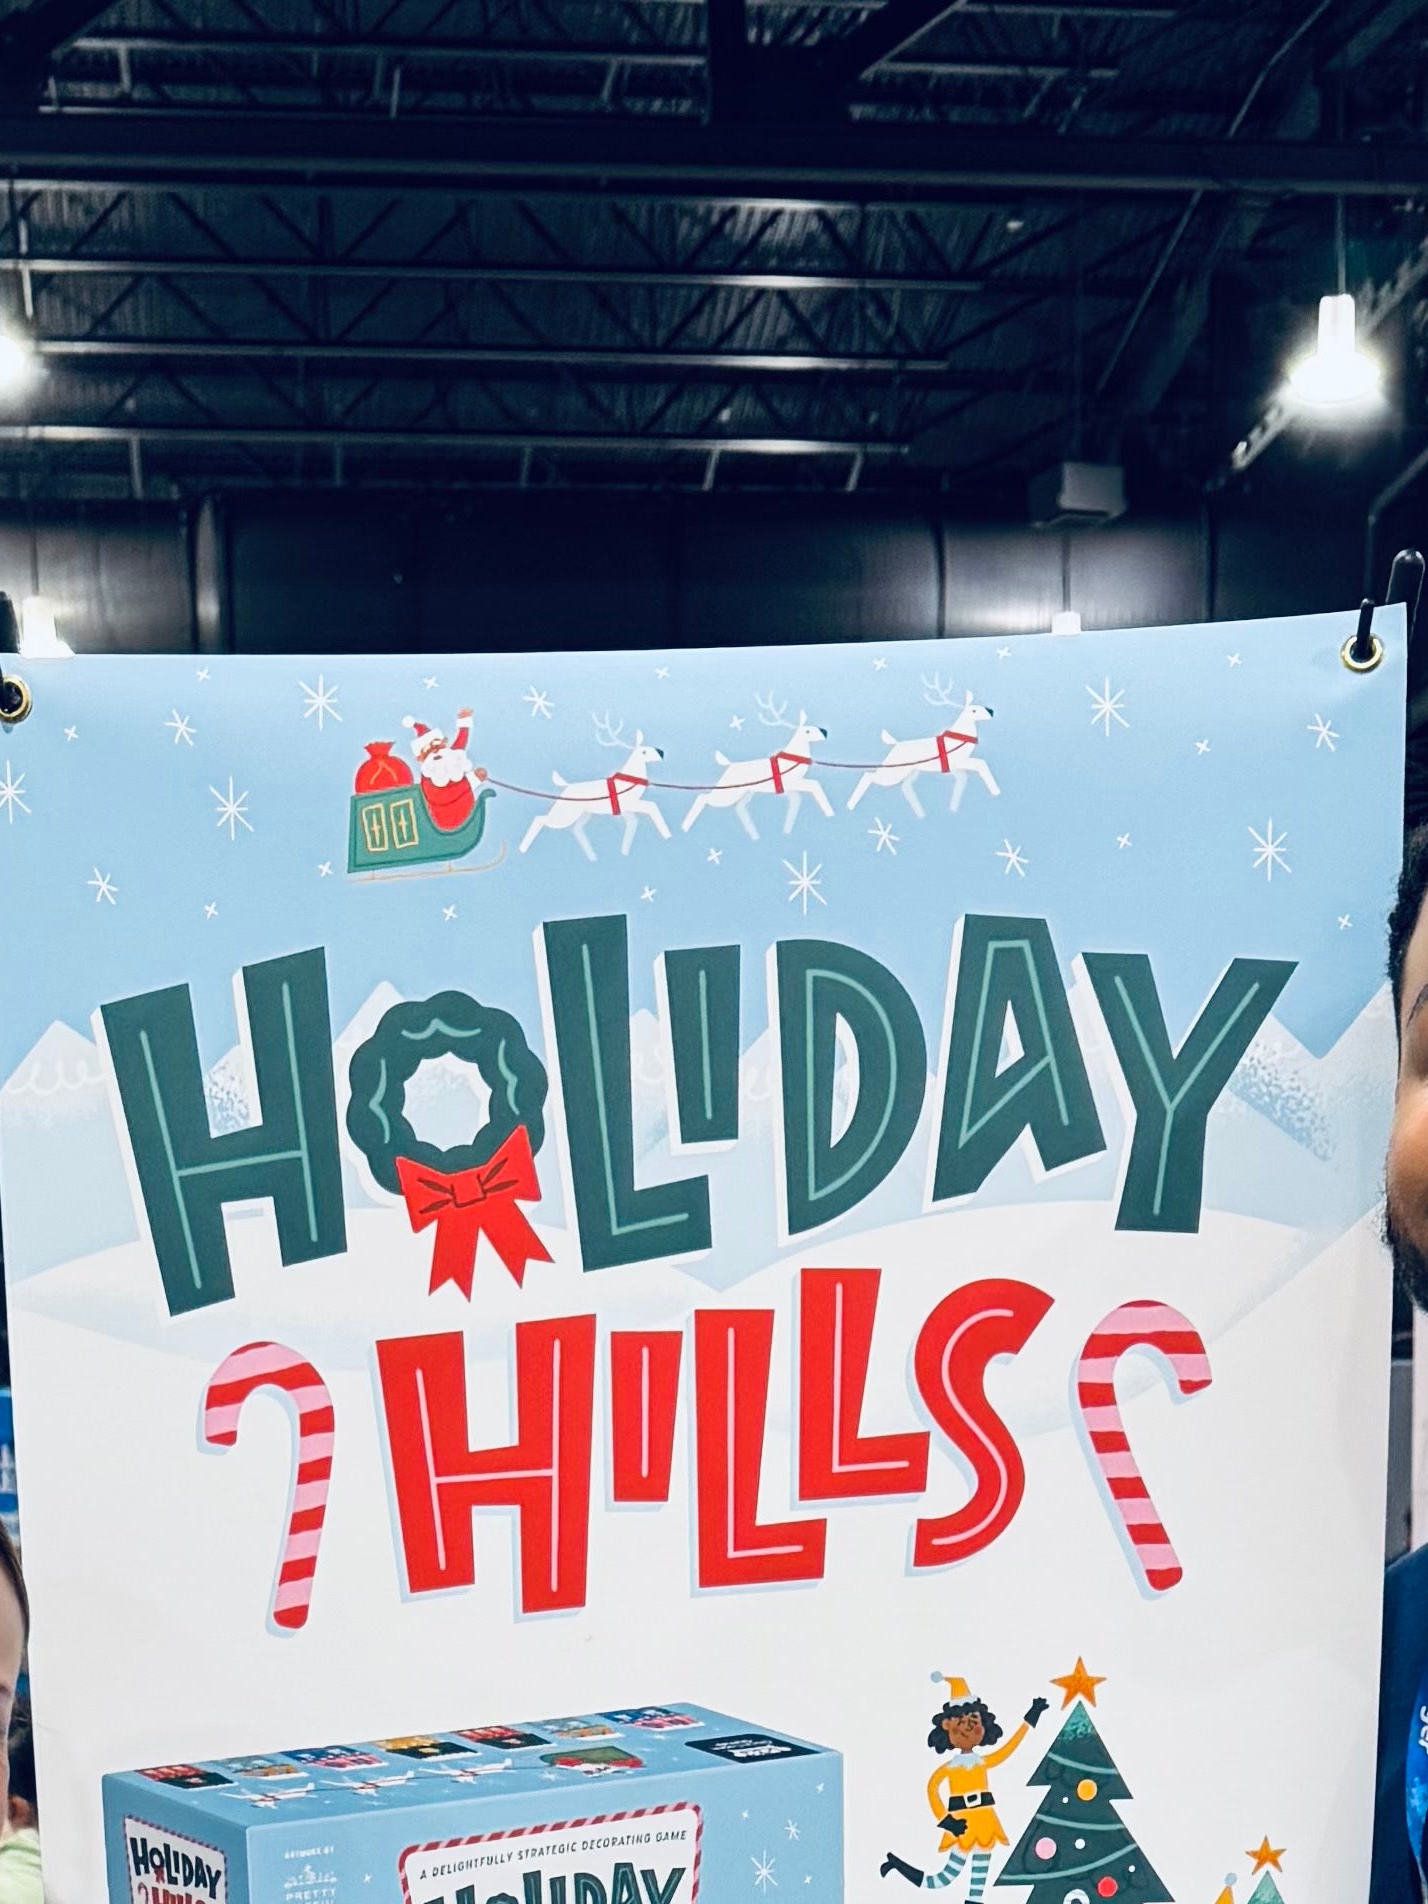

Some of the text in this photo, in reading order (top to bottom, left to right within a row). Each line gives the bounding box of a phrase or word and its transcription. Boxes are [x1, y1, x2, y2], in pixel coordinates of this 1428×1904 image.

[98, 913, 1300, 1316] HOLIDAY
[375, 1268, 1056, 1616] HILLS
[129, 1837, 222, 1900] HOLIDAY
[420, 1829, 688, 1880] A DELIGHTFULLY STRATEGIC DECORATING GAME
